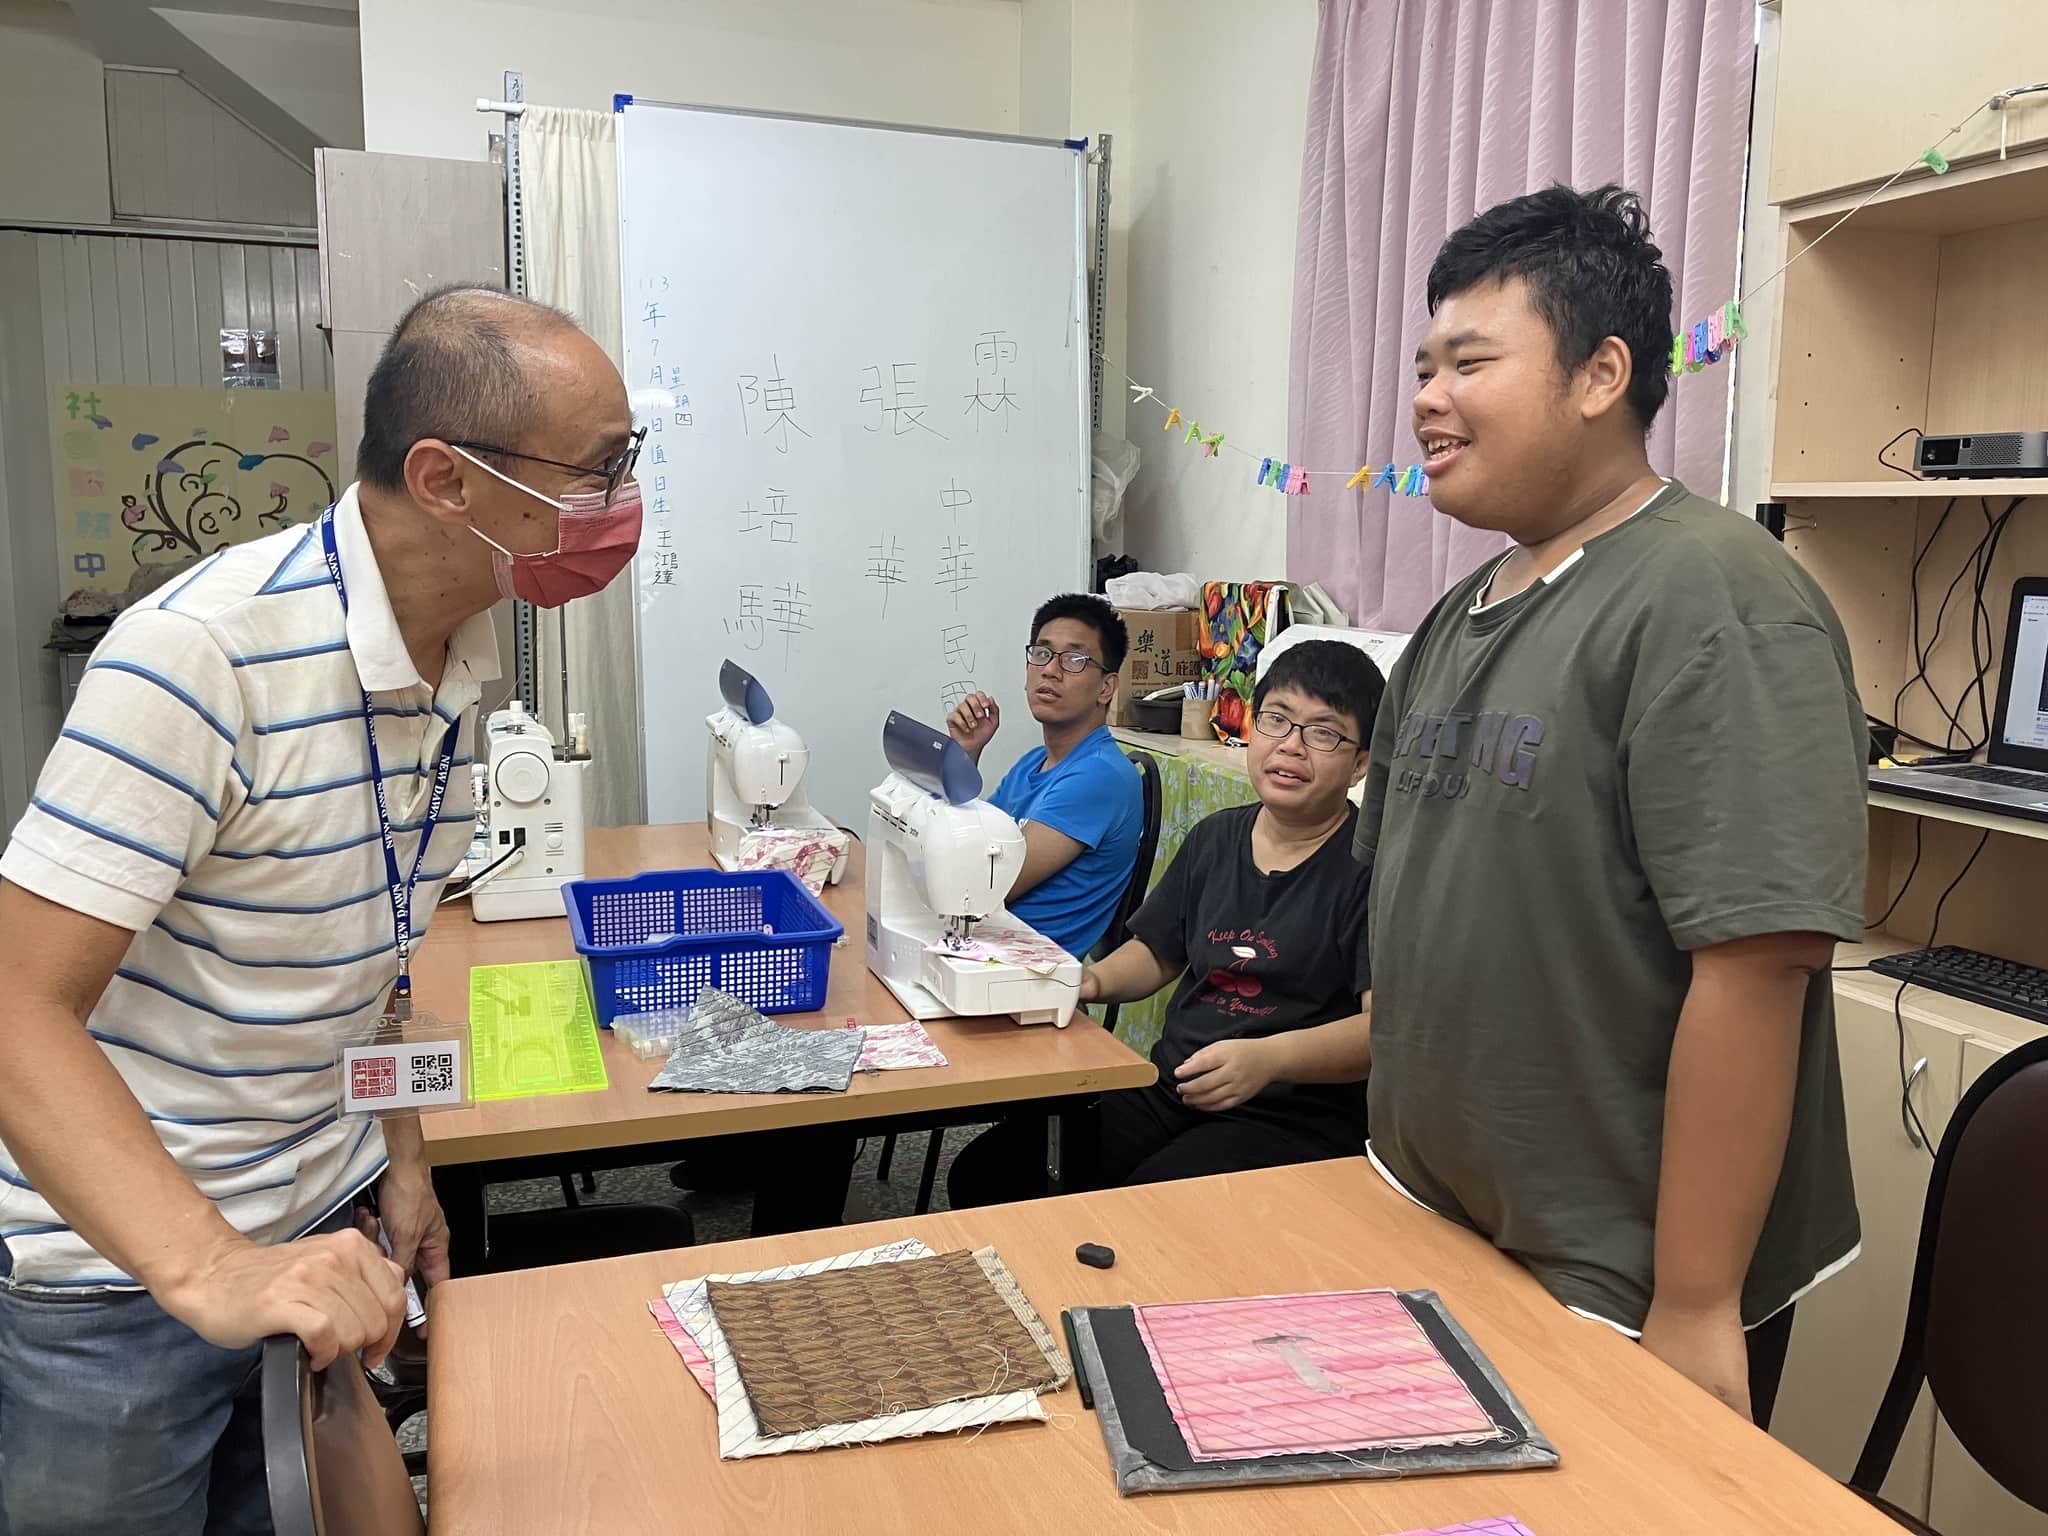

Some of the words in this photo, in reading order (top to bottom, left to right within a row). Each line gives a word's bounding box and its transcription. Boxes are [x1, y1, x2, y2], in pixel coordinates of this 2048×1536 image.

[436, 754, 451, 783] NEW
[428, 785, 444, 821] DAWN
[391, 883, 408, 918] DAWN
